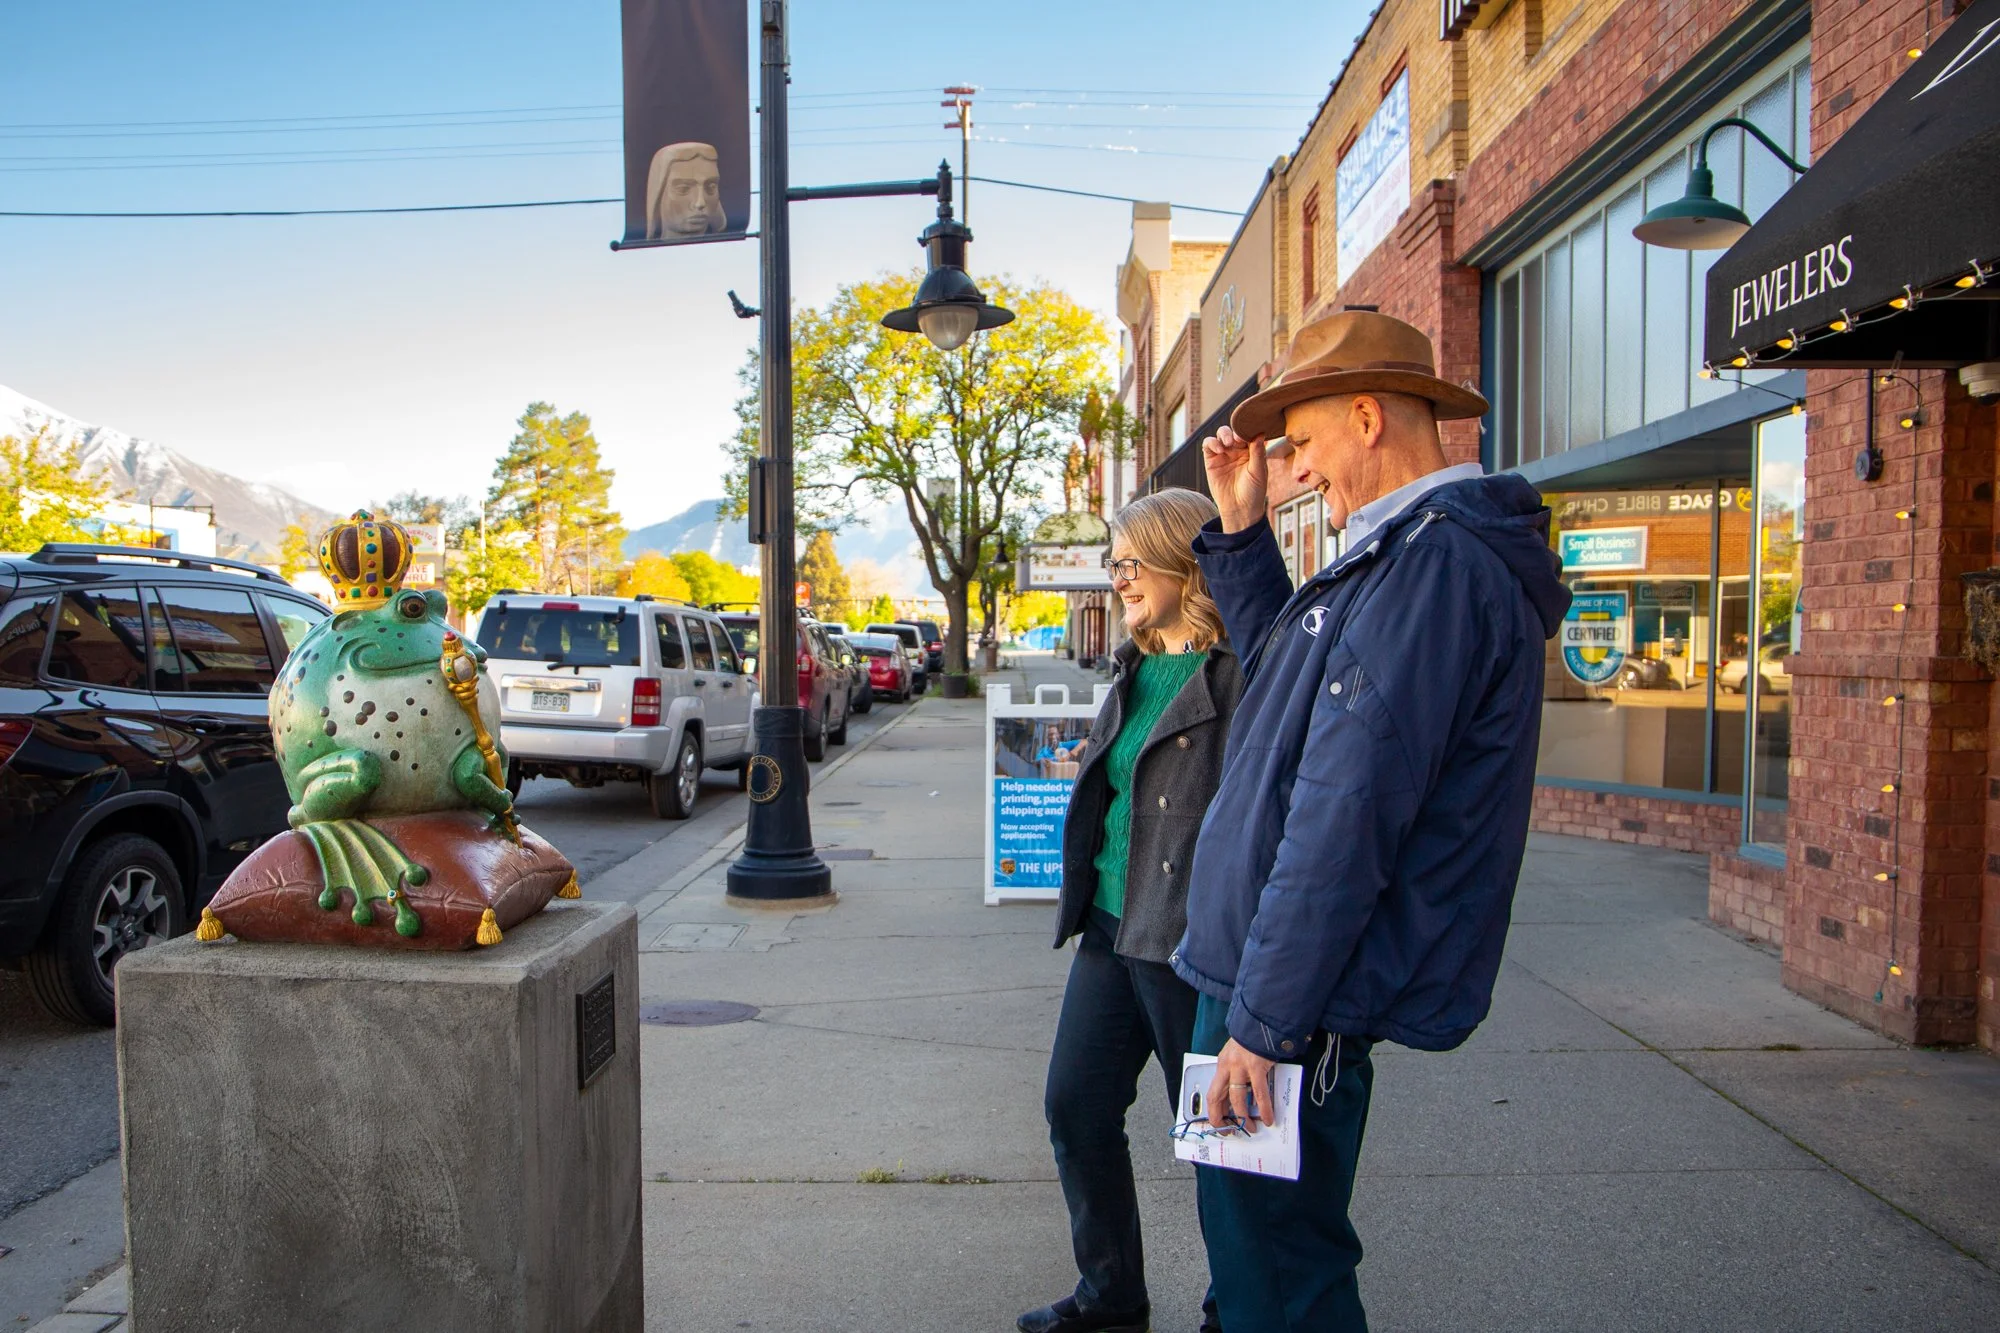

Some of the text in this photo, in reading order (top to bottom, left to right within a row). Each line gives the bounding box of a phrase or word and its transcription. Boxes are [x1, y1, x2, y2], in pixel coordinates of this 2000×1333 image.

[1731, 235, 1852, 339] JEWELERS
[1568, 536, 1637, 551] Small Business
[1580, 549, 1623, 562] Solutions
[405, 573, 428, 582] HRU
[1567, 626, 1622, 641] CERTIFIED
[1001, 782, 1024, 793] Help
[1026, 782, 1063, 792] needed
[1001, 794, 1072, 806] printing, packi
[1001, 806, 1064, 817] shipping and
[1000, 823, 1055, 832] Now accepting
[1000, 832, 1047, 840] applications.
[1019, 862, 1041, 873] THE
